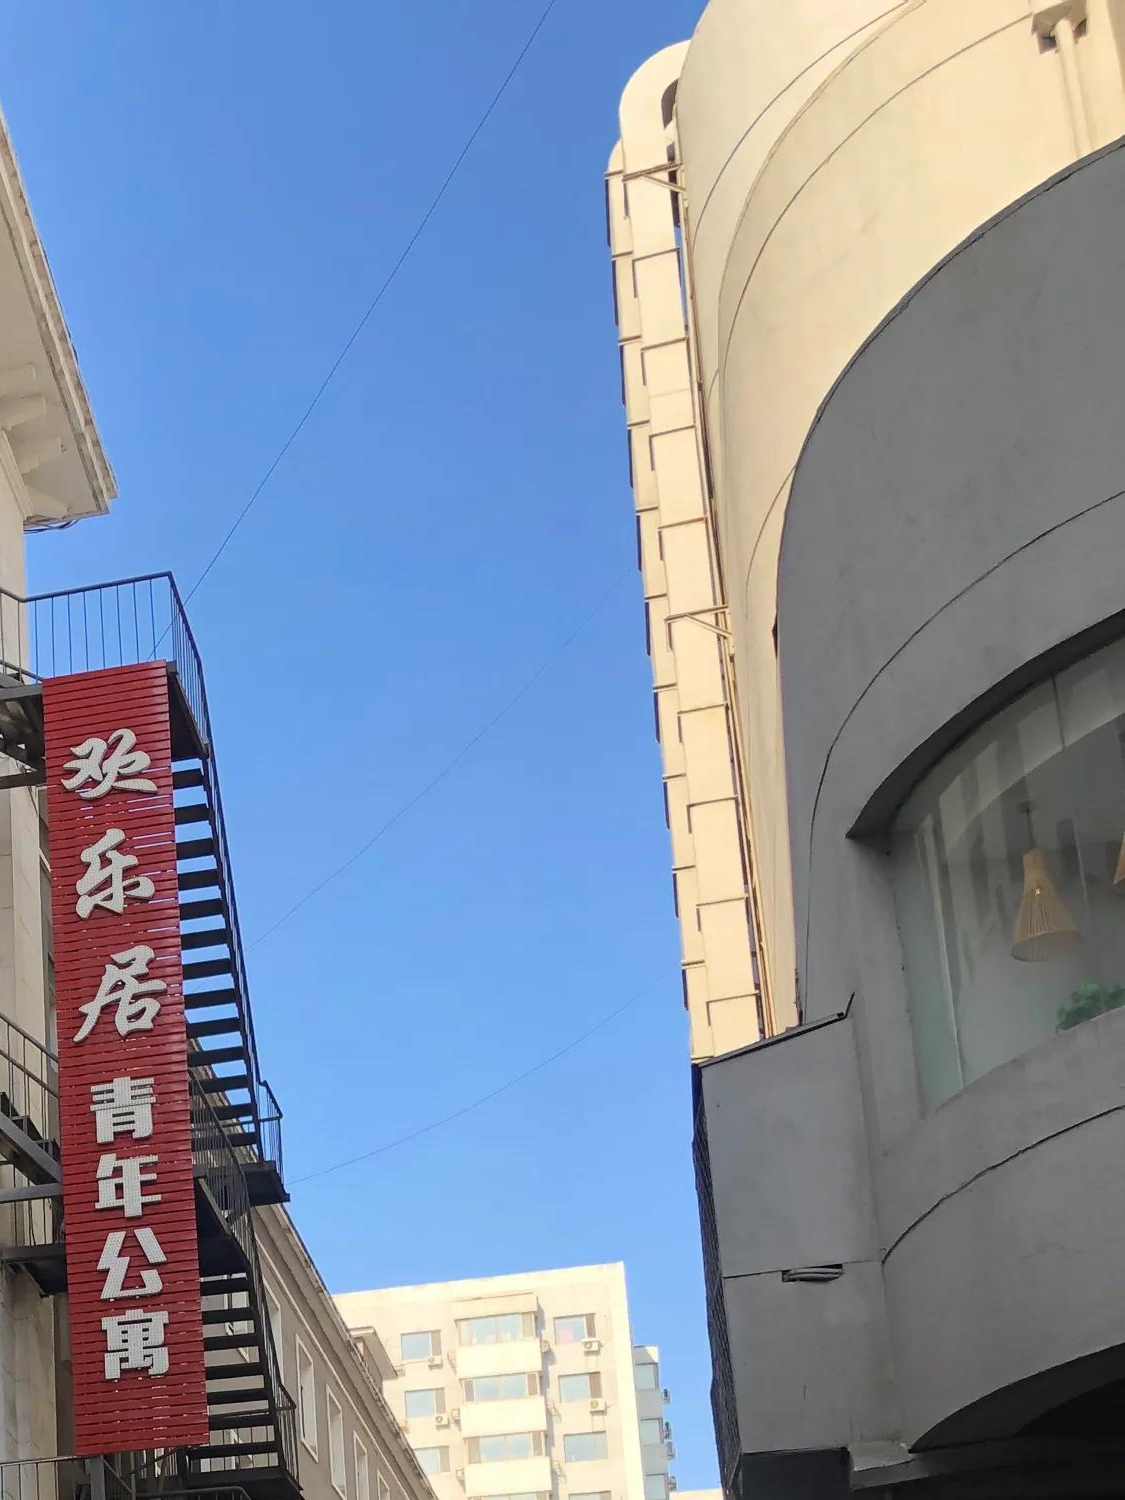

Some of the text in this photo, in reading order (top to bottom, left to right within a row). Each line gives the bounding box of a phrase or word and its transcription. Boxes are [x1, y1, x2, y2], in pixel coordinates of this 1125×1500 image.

[61, 729, 170, 1380] 欢乐居青年公寓
